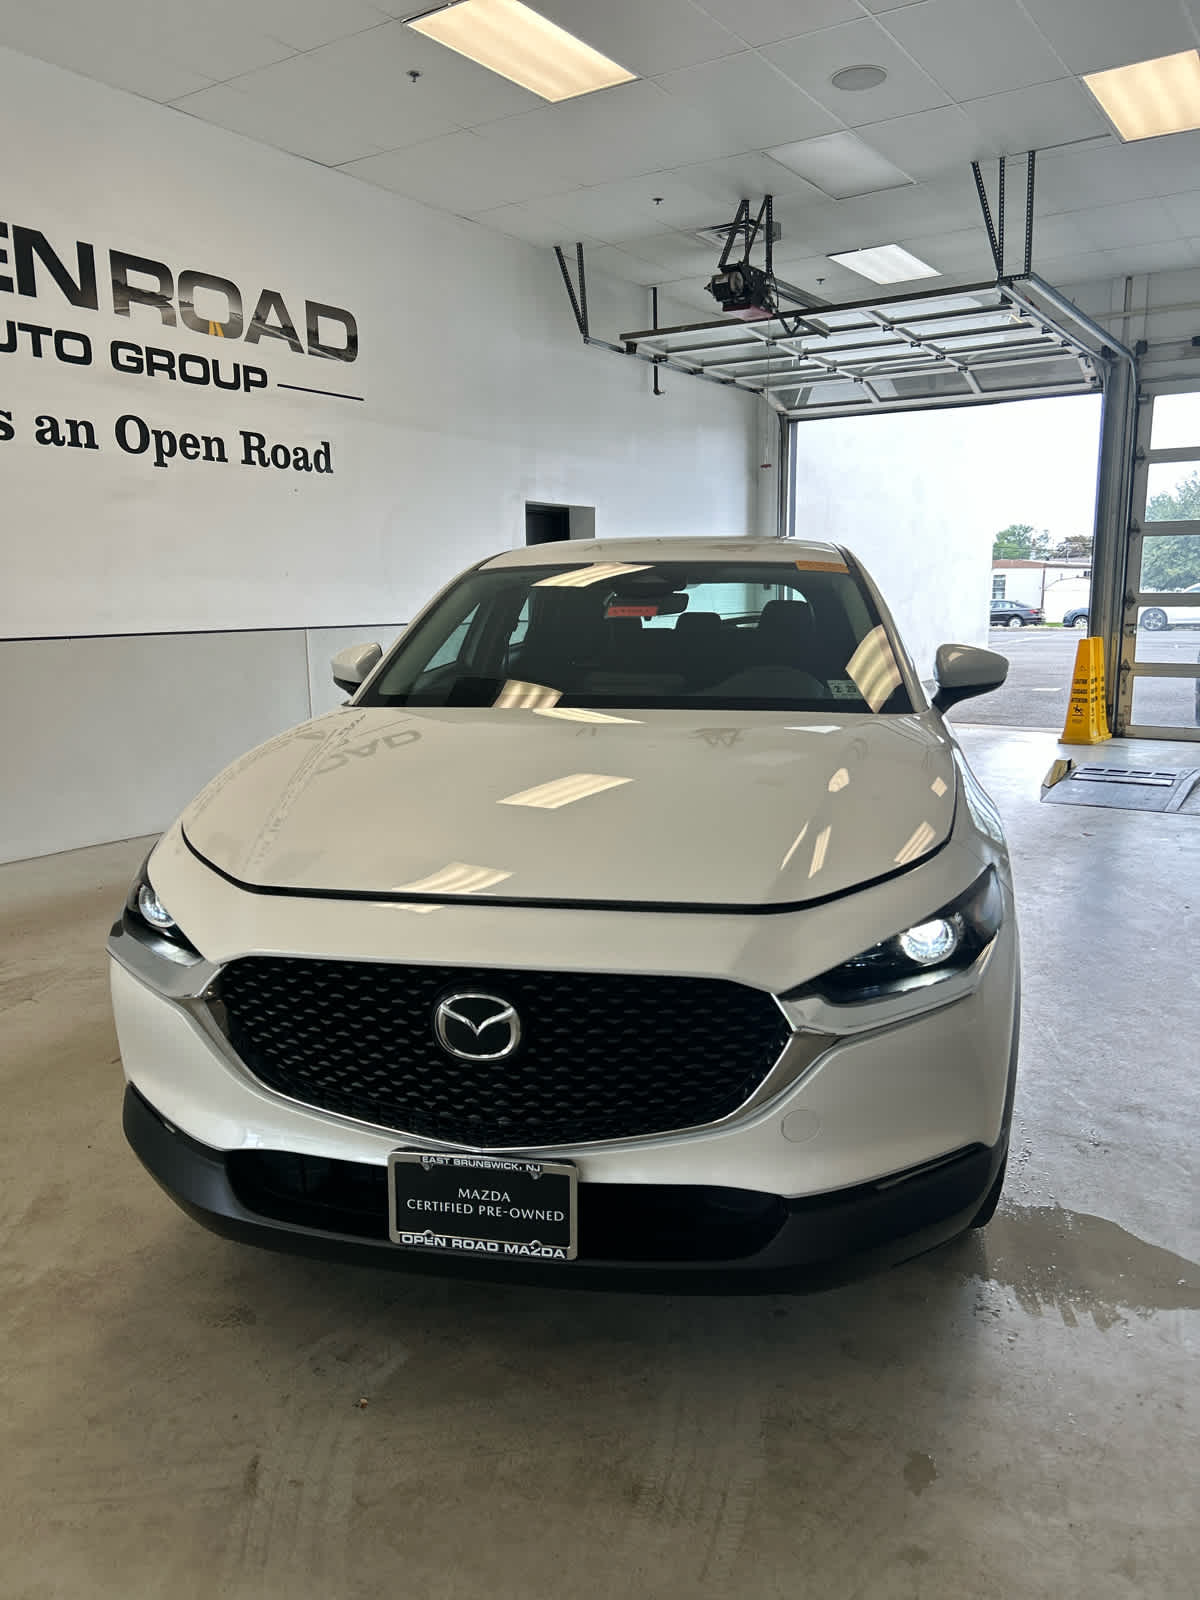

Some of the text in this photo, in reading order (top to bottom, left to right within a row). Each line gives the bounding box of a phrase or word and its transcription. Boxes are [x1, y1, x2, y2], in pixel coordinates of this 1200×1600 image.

[0, 222, 358, 363] N ROAD
[110, 340, 268, 392] GROUP
[35, 415, 99, 450] an
[115, 414, 228, 467] Open
[239, 430, 333, 473] Road
[422, 1156, 541, 1172] EAST BRUNSWICK, NJ
[458, 1188, 511, 1203] MAZDA
[406, 1199, 565, 1222] CERTIFIED PRE-OWNED
[401, 1234, 565, 1259] OPEN ROAD MAZDA
